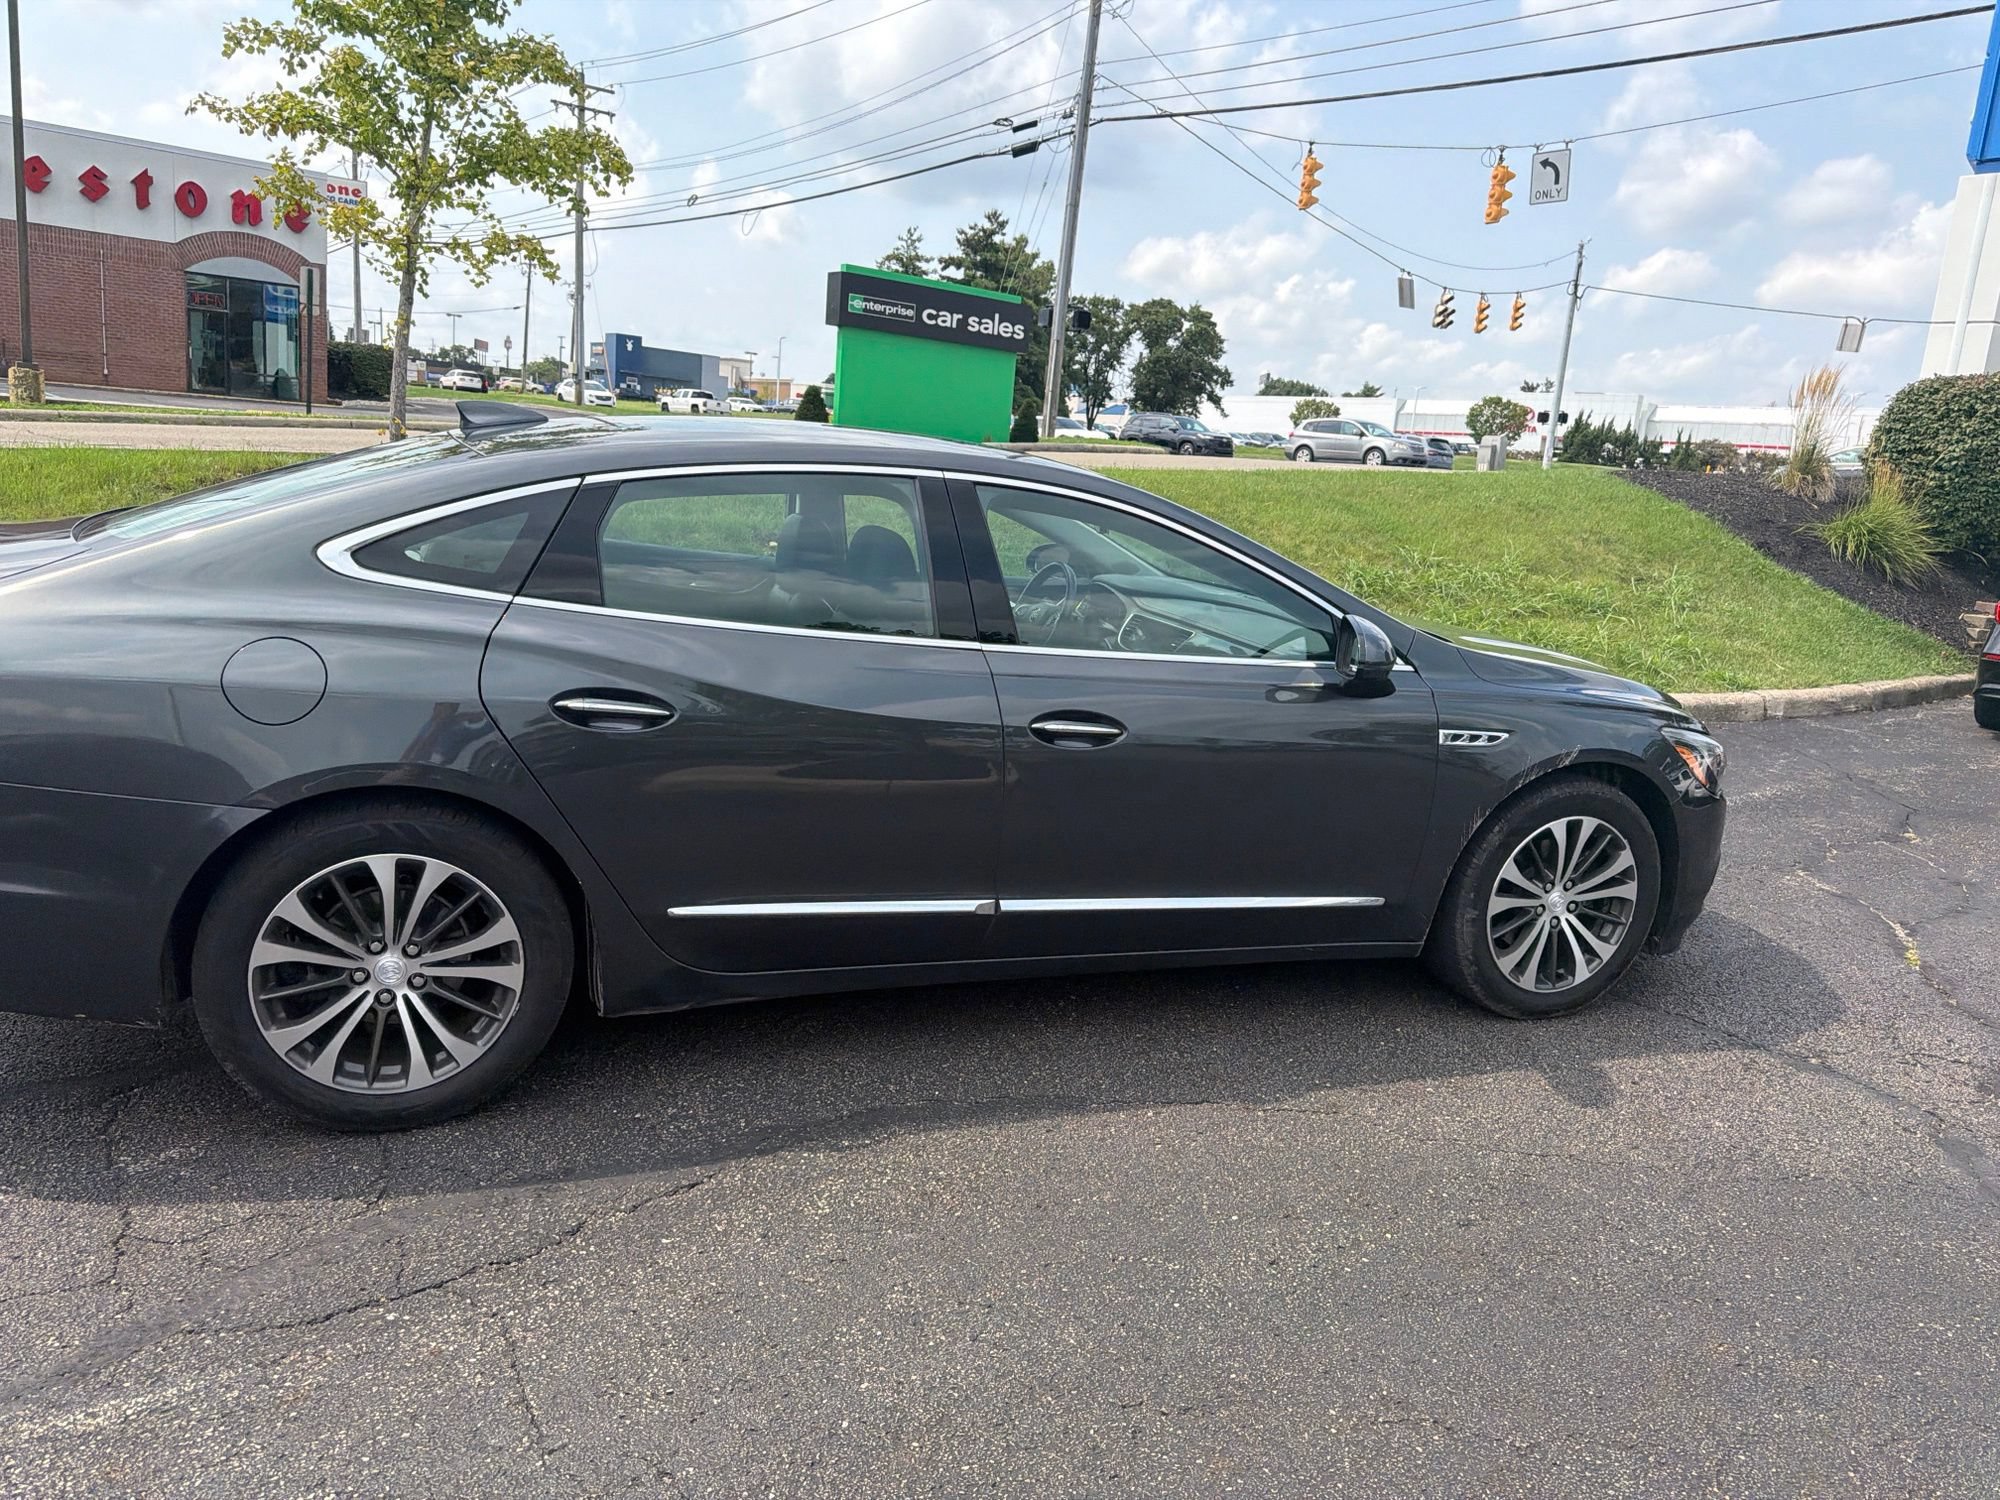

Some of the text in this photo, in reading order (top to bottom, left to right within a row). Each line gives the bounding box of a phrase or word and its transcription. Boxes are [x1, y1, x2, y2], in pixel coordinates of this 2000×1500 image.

[1535, 188, 1562, 200] ONLY
[851, 299, 1025, 340] enterprise car sales
